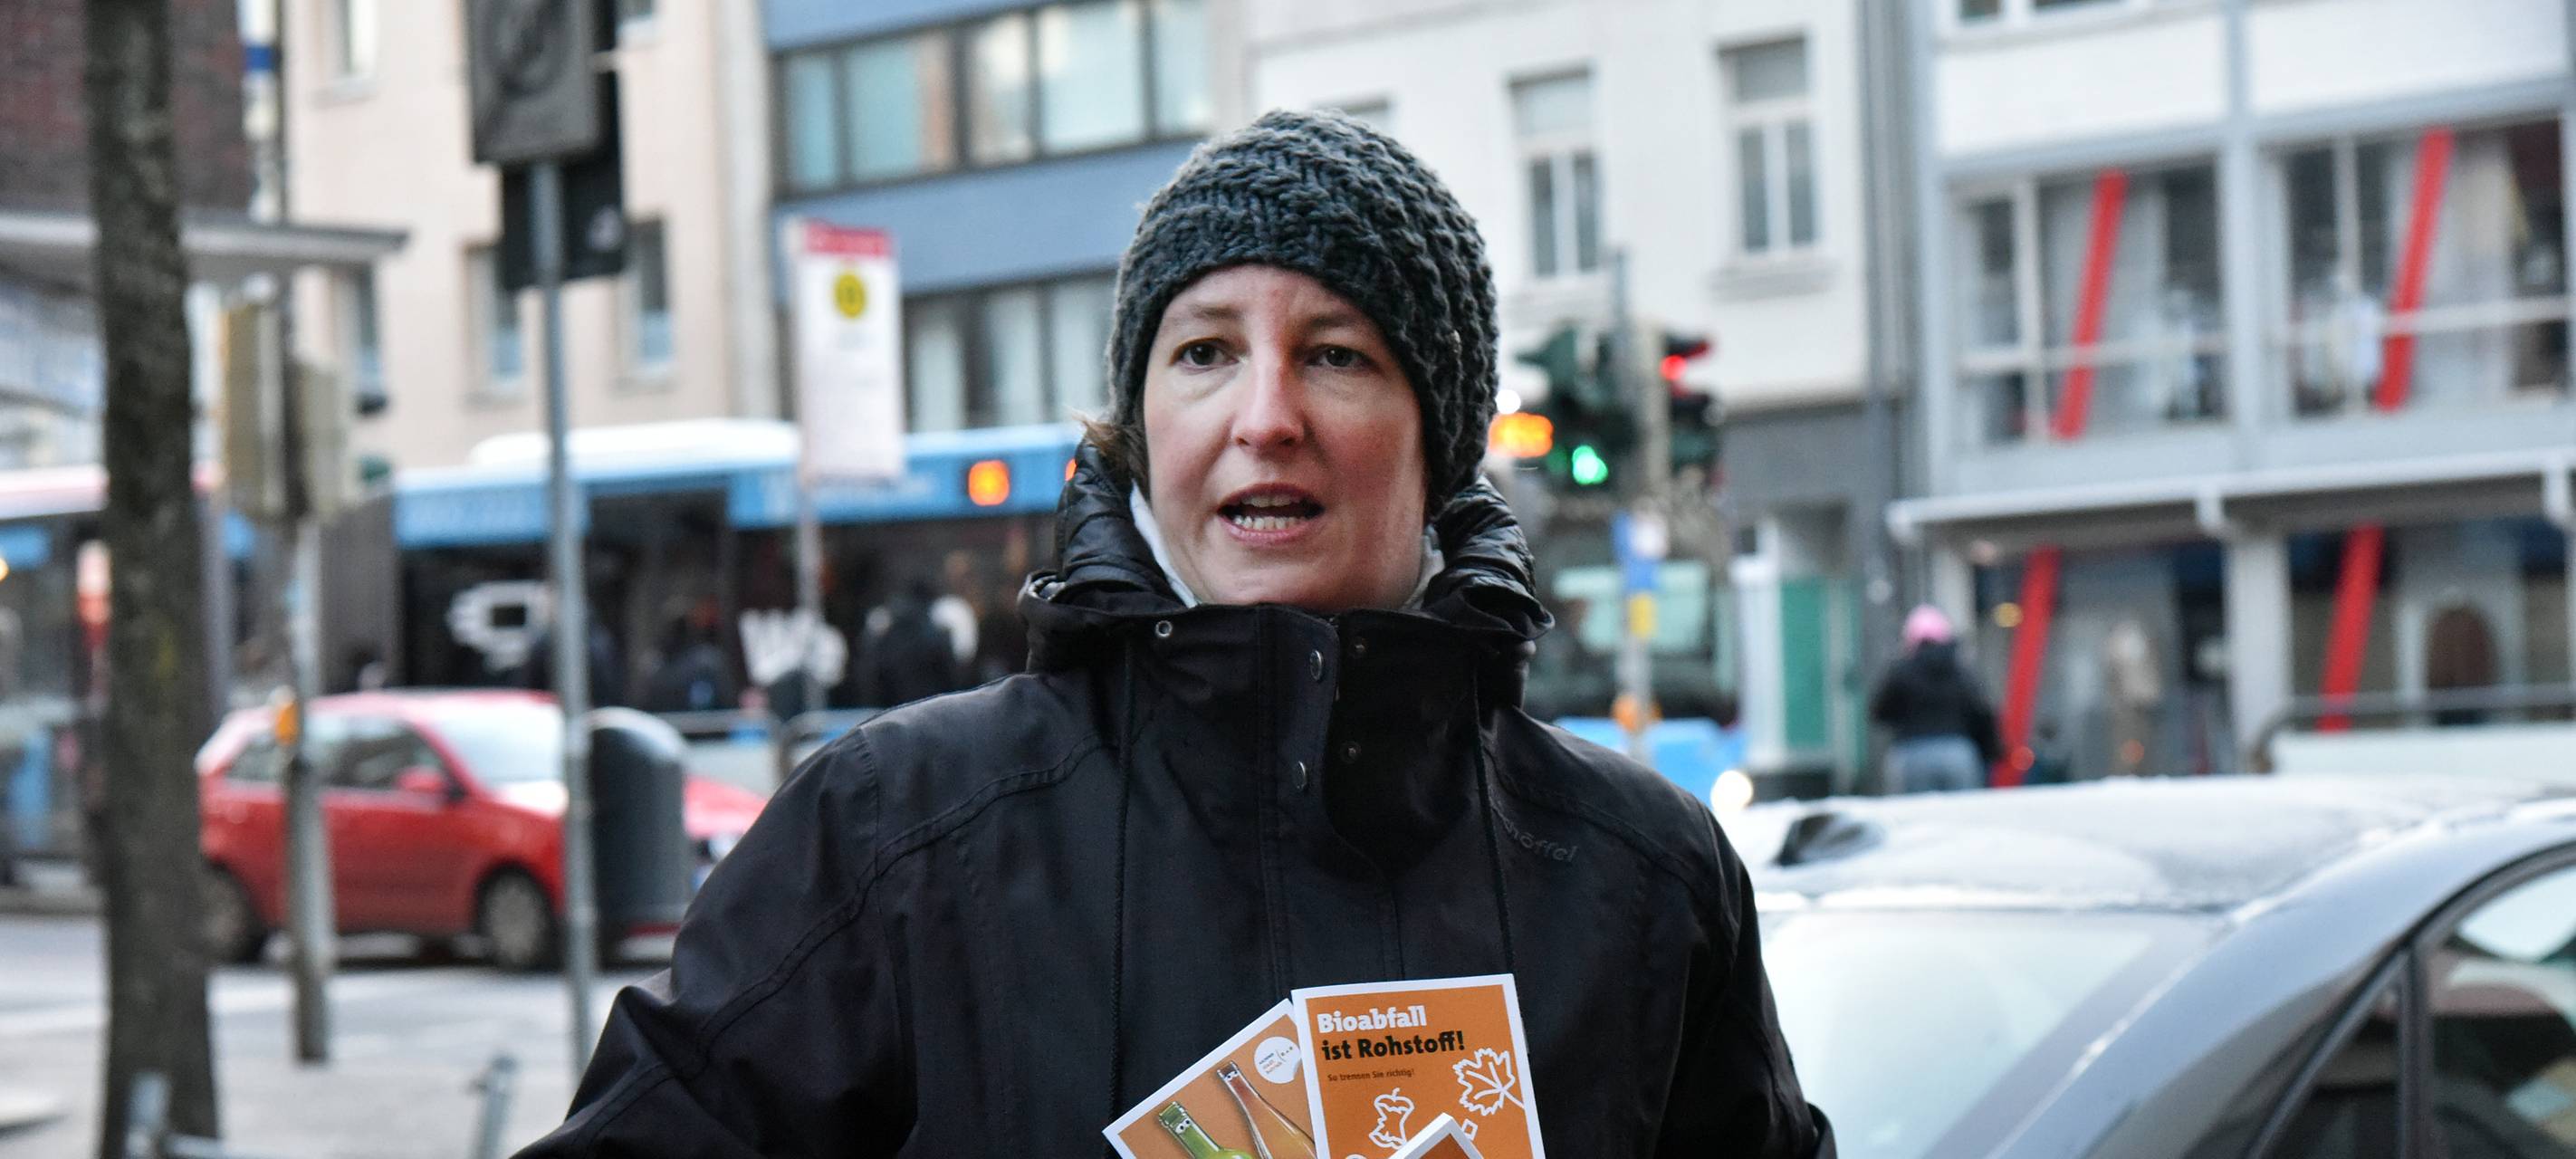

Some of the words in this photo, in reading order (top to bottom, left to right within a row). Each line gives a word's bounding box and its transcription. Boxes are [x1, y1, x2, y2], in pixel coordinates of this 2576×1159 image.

[1317, 1005, 1427, 1033] Bioabfall
[1322, 1039, 1353, 1060] ist
[1358, 1030, 1465, 1058] Rohstoff!
[1327, 1073, 1338, 1081] So
[1372, 1070, 1384, 1078] Sie
[1386, 1068, 1415, 1078] richtig!
